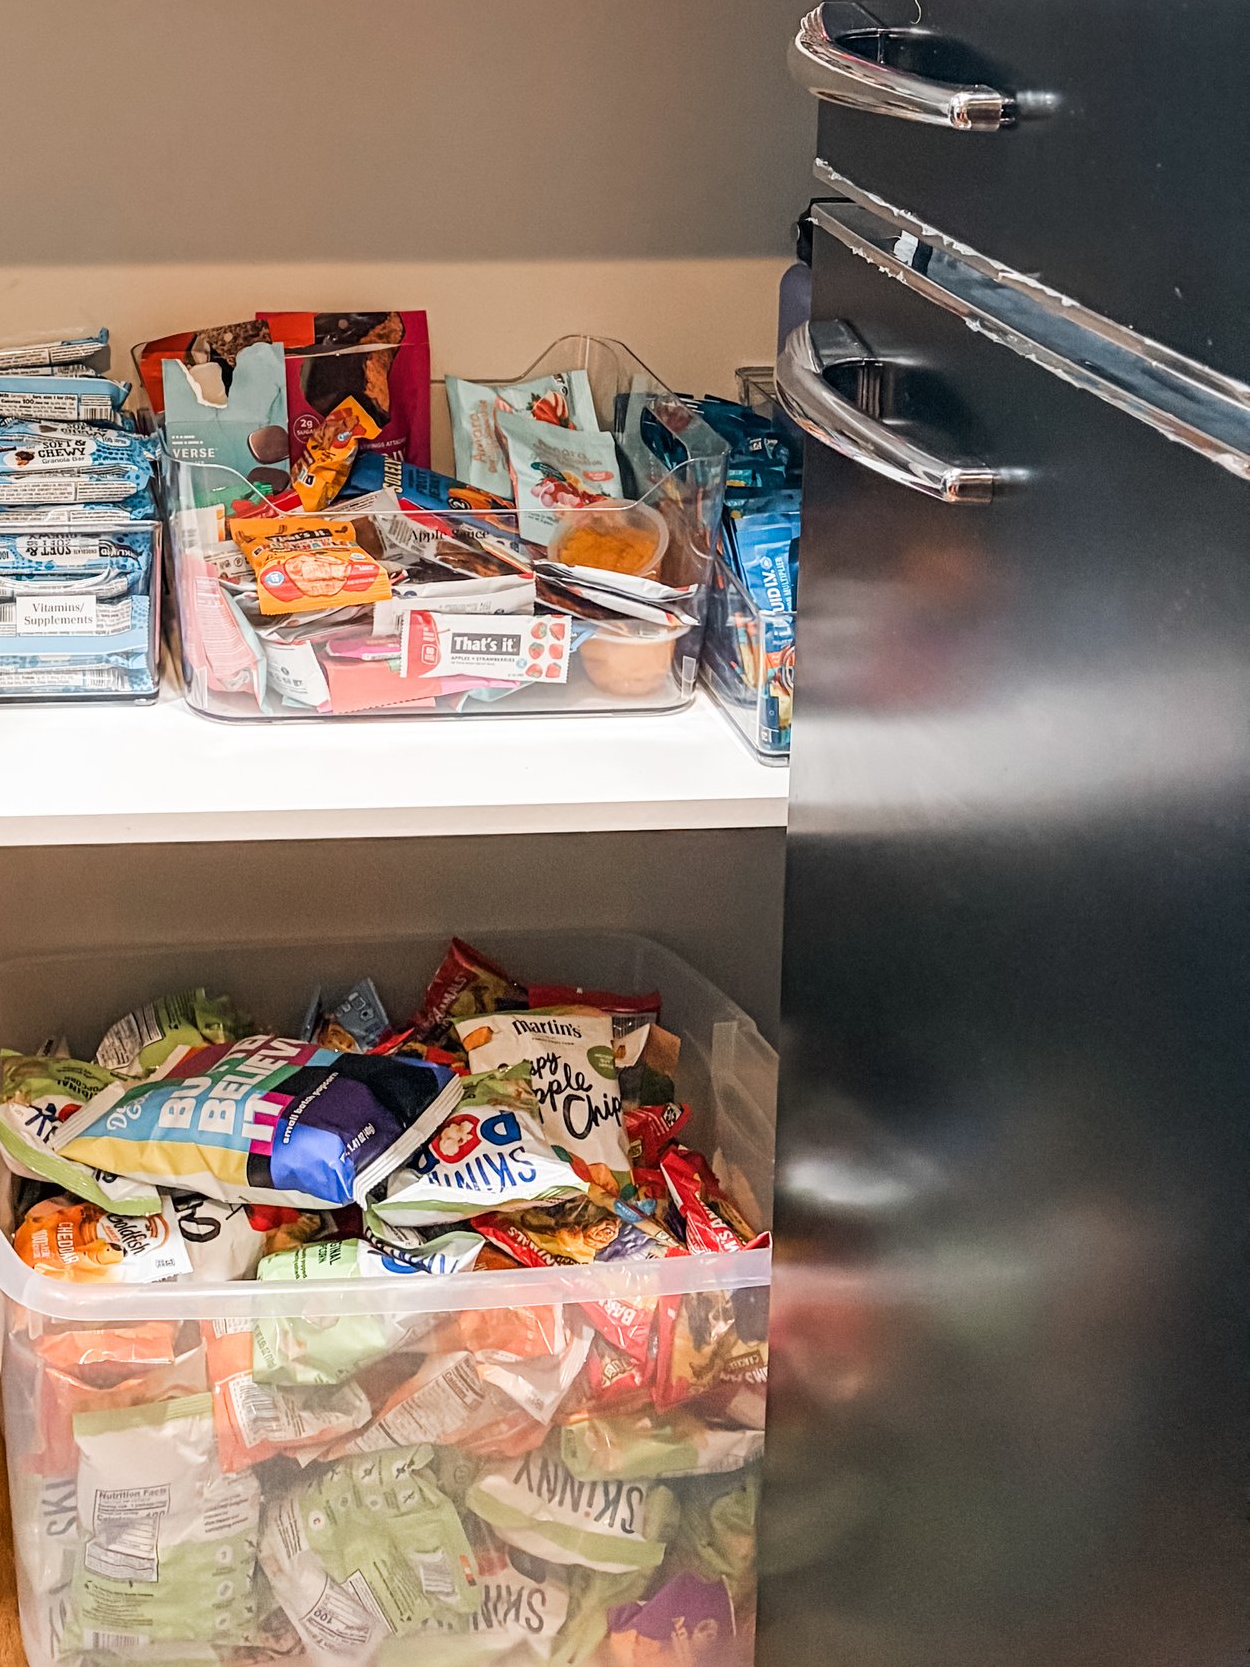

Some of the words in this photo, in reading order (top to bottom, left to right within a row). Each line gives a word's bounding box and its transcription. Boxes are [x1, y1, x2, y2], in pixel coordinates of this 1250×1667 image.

[299, 419, 314, 430] 2g
[42, 439, 72, 450] SOFT
[37, 447, 87, 459] CHEWY
[41, 456, 71, 465] Granola
[171, 447, 217, 459] VERSE
[383, 454, 404, 495] SOLELY
[266, 530, 311, 543] That's
[410, 528, 446, 543] Apple
[451, 527, 491, 540] Sauce
[31, 601, 85, 617] Vitamins/
[23, 613, 94, 628] Supplements
[453, 636, 498, 651] That's
[511, 1019, 583, 1039] martin's
[197, 1035, 308, 1135] BELIEV
[283, 1113, 297, 1145] small
[310, 1071, 340, 1098] popcorn
[241, 1091, 287, 1143] IT
[106, 1213, 151, 1257] Goldfish
[57, 1221, 80, 1266] CHEDDAR
[514, 1455, 644, 1535] SKINNY
